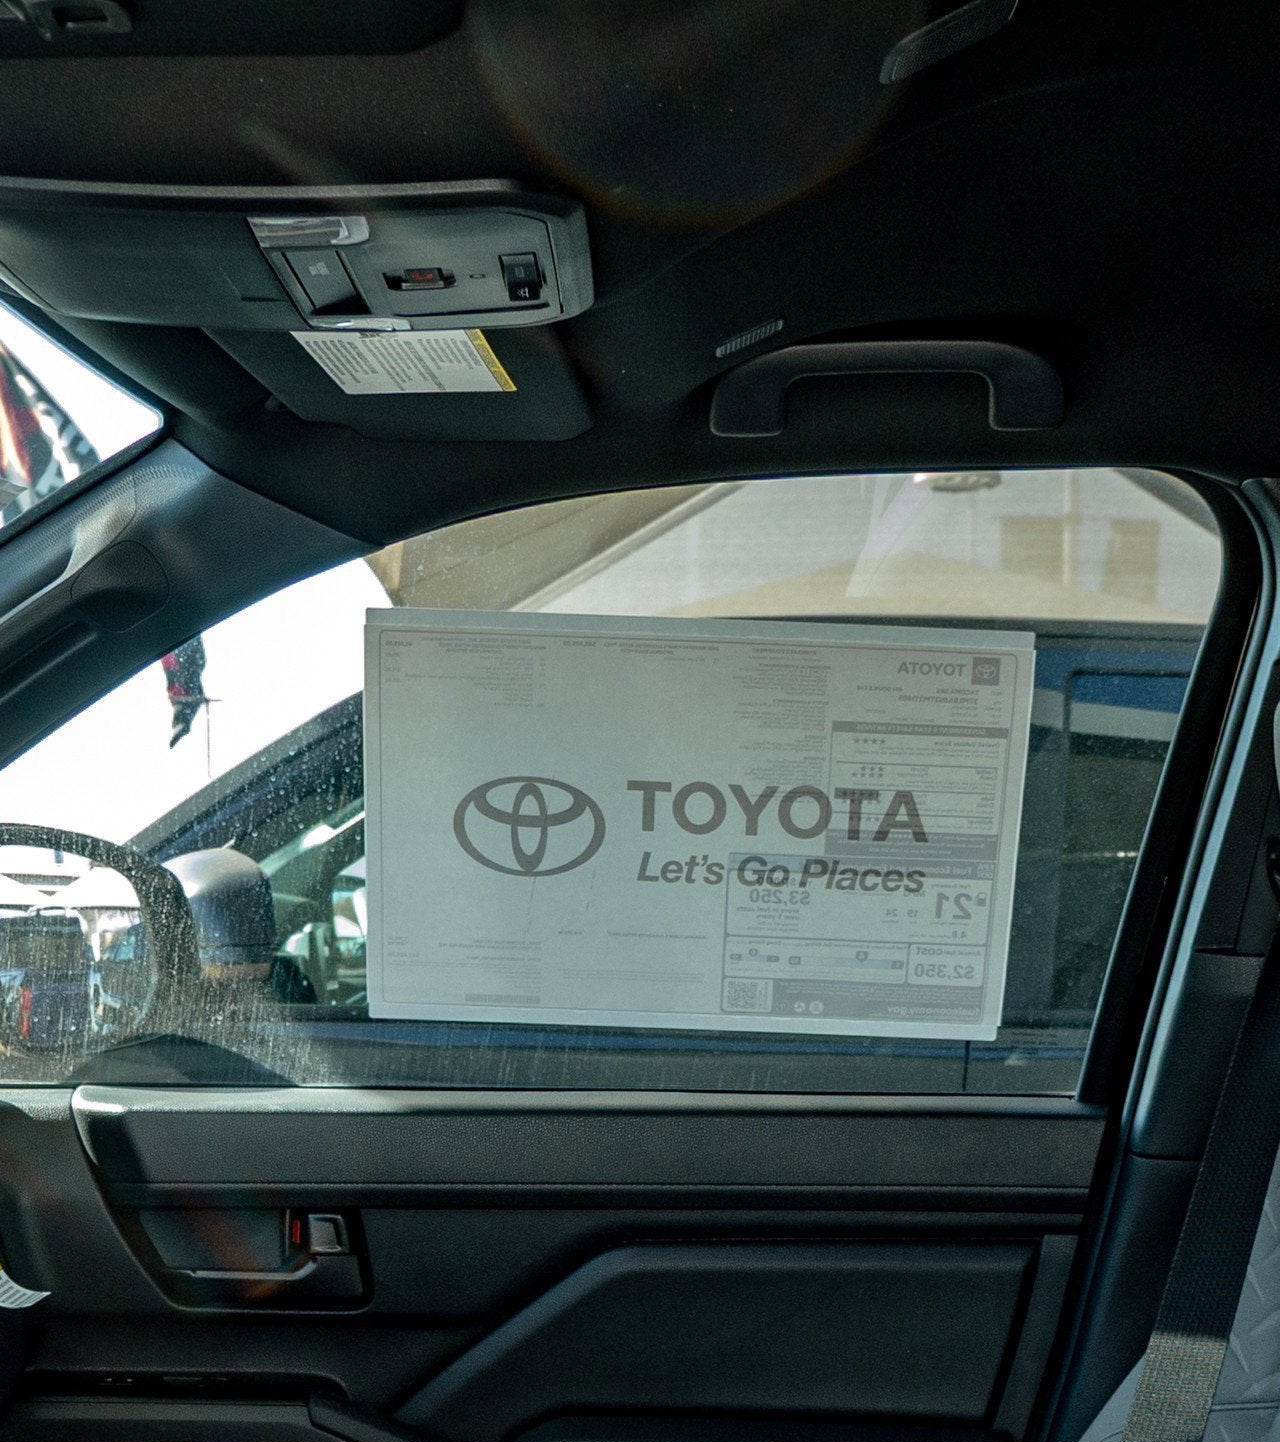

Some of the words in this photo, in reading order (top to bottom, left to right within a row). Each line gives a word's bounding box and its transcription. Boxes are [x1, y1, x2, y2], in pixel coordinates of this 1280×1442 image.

[627, 779, 928, 843] TOYOTA
[637, 851, 725, 885] Let's
[736, 856, 790, 887] Go
[798, 858, 926, 893] Places
